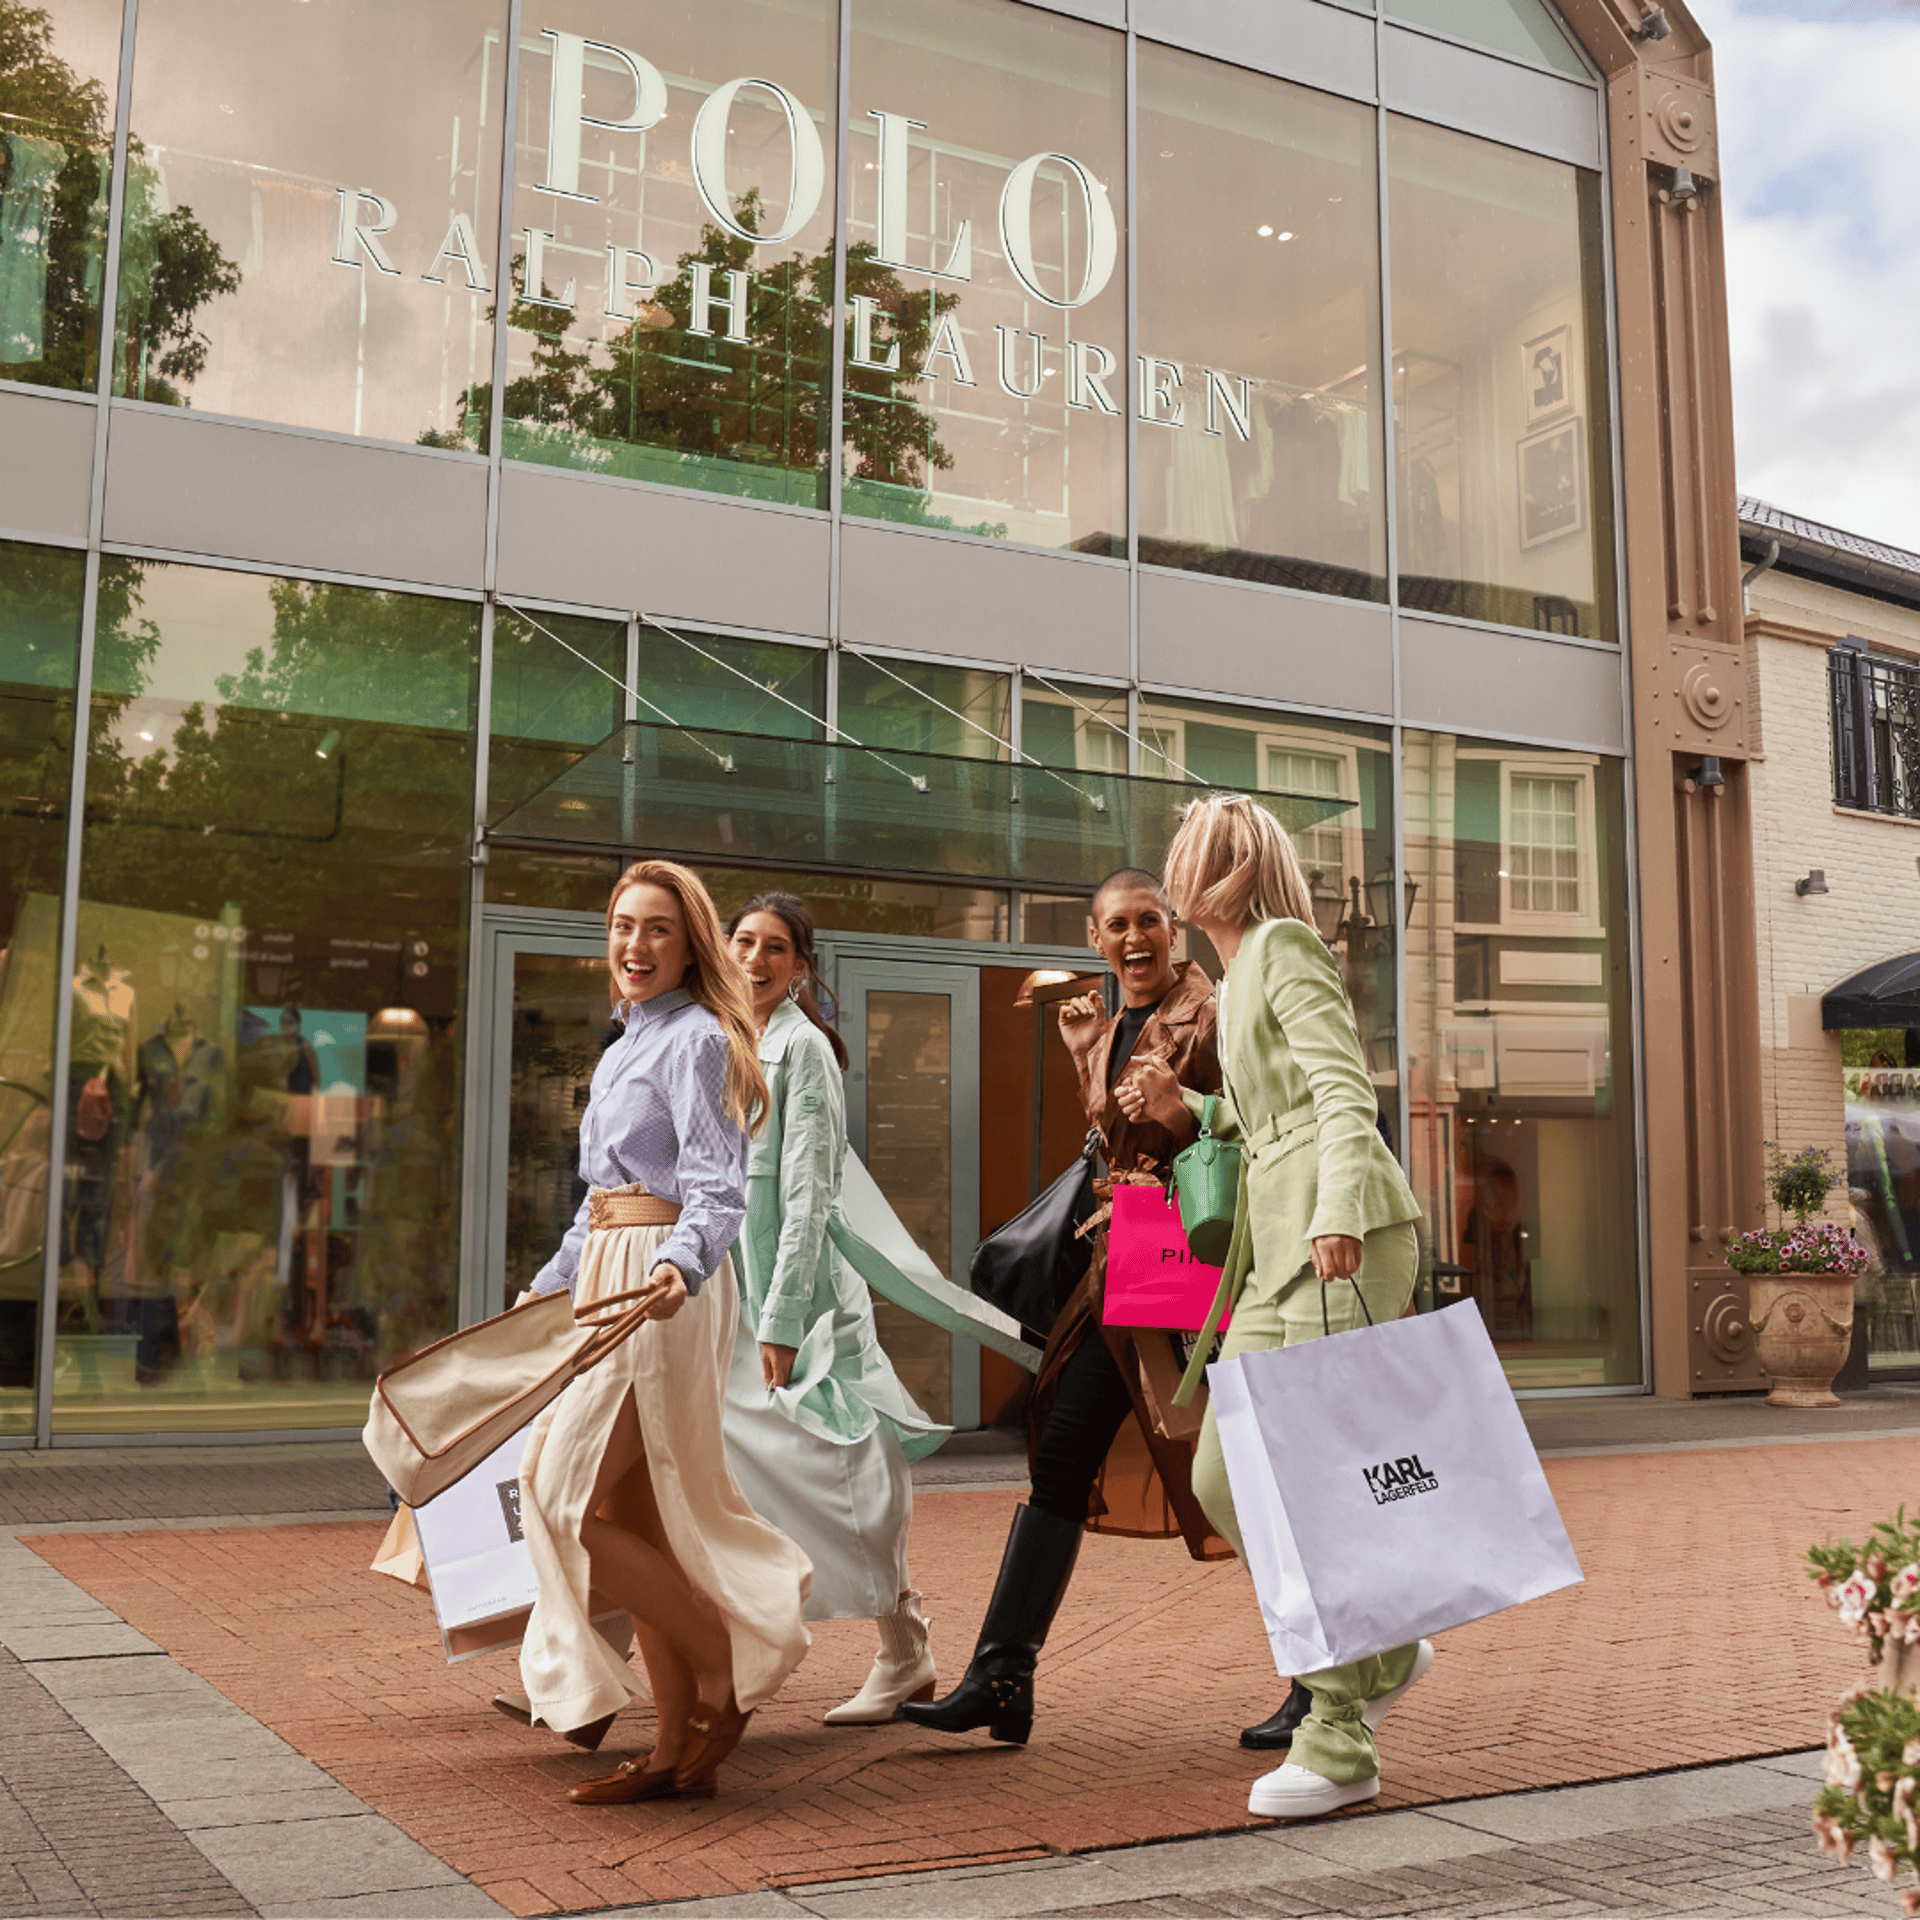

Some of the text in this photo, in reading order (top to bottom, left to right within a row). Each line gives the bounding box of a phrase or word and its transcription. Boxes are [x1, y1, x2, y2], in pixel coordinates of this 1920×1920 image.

[532, 28, 1118, 310] POLO
[330, 187, 1256, 442] RALPH LAUREN
[1362, 1453, 1435, 1494] KARL
[1373, 1478, 1440, 1506] LAGERFELD
